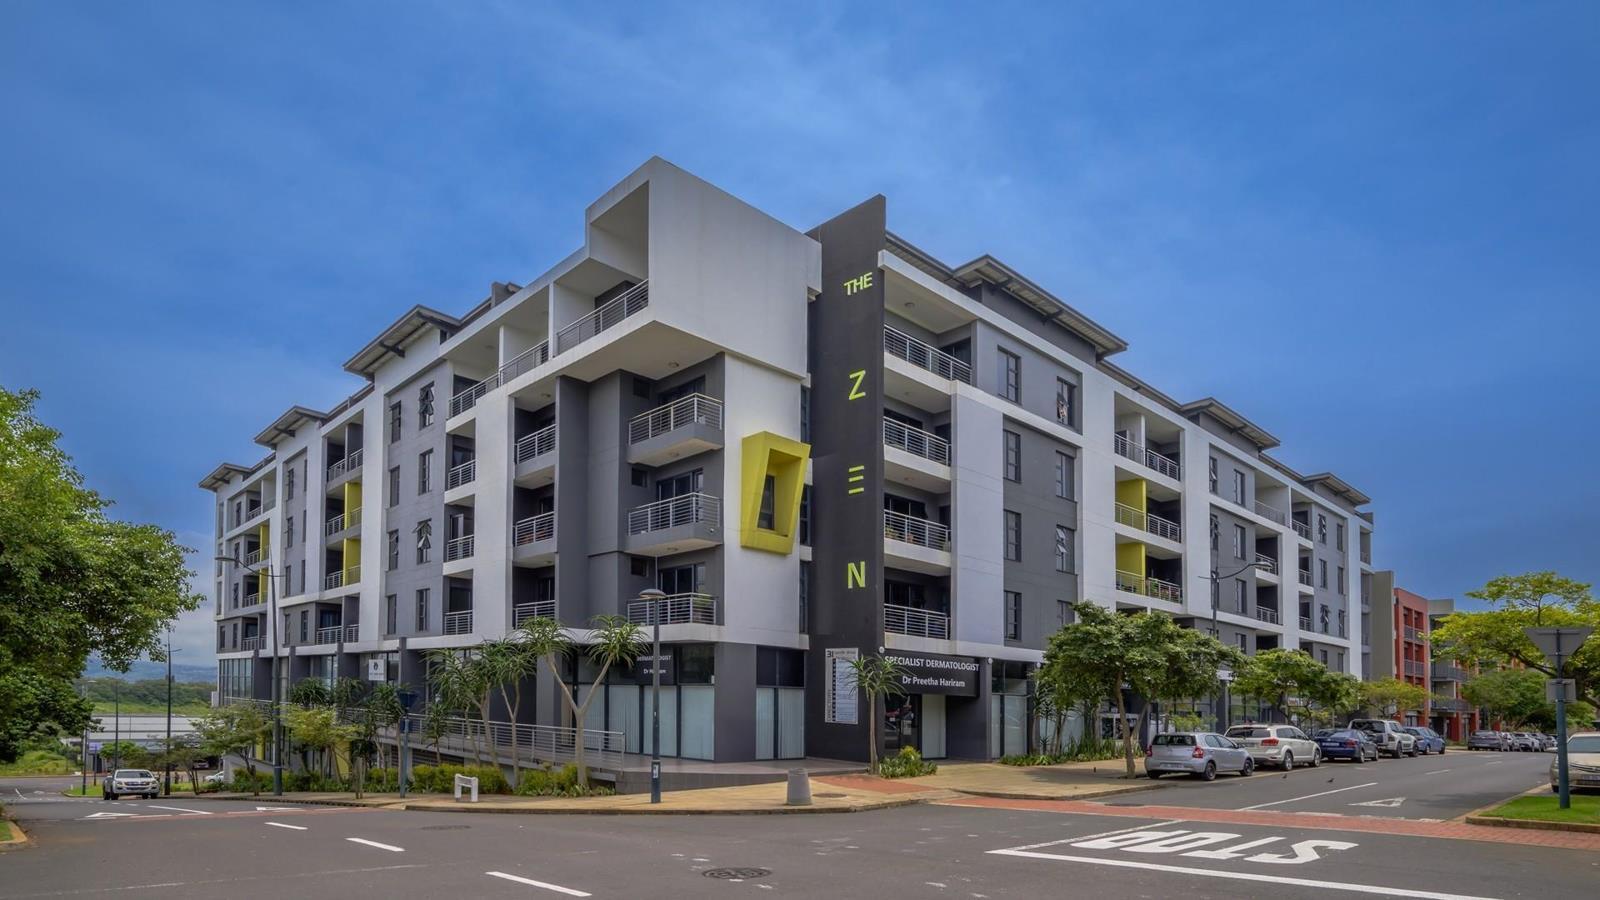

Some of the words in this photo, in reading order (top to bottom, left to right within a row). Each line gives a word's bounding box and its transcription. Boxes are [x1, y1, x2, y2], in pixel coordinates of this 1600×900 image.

[843, 271, 873, 296] THE
[884, 655, 924, 668] SPECIALIST
[925, 659, 980, 672] DERMATOLOGIST
[902, 675, 912, 685] Dr
[912, 676, 939, 686] Preetha
[939, 678, 966, 688] Hariram
[1069, 829, 1360, 864] STOP
